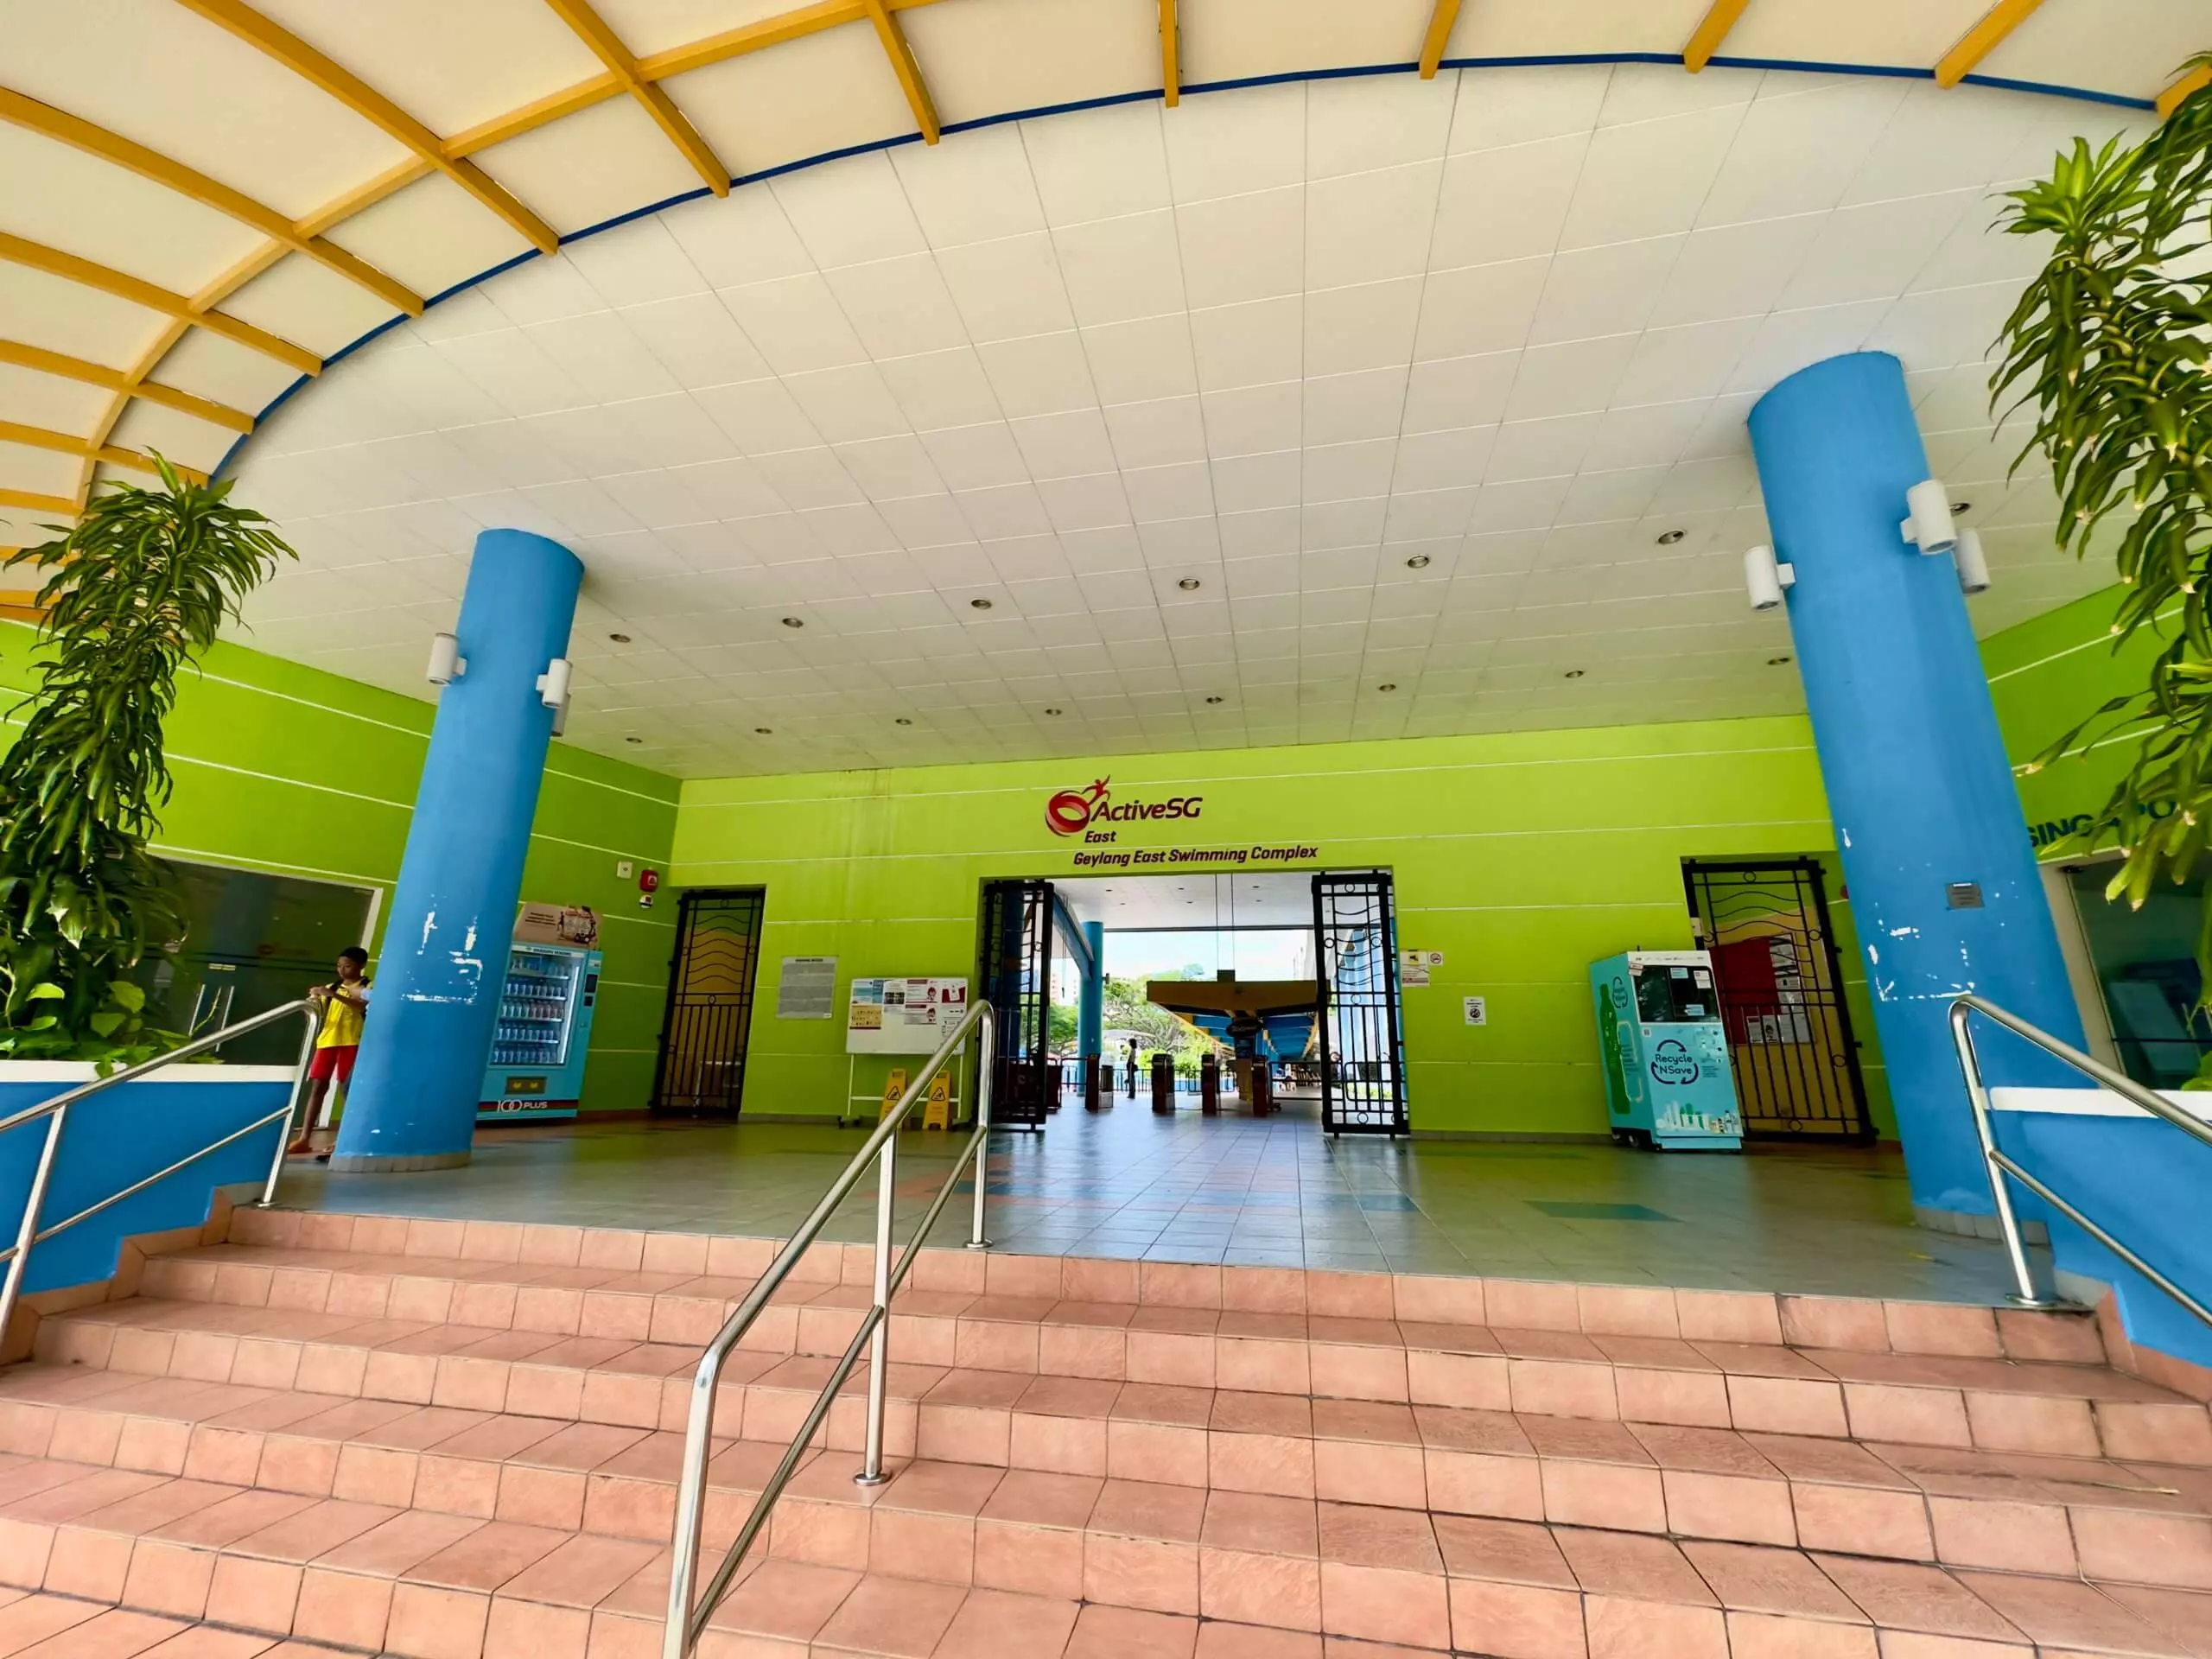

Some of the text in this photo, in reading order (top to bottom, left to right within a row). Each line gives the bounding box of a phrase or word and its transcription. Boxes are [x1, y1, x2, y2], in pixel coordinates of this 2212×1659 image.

[1090, 797, 1203, 822] ActiveSG
[1084, 830, 1116, 843] East
[1073, 845, 1318, 868] Geylang East Swimming Complex
[1655, 1054, 1693, 1065] Recycle
[497, 1099, 522, 1113] 100
